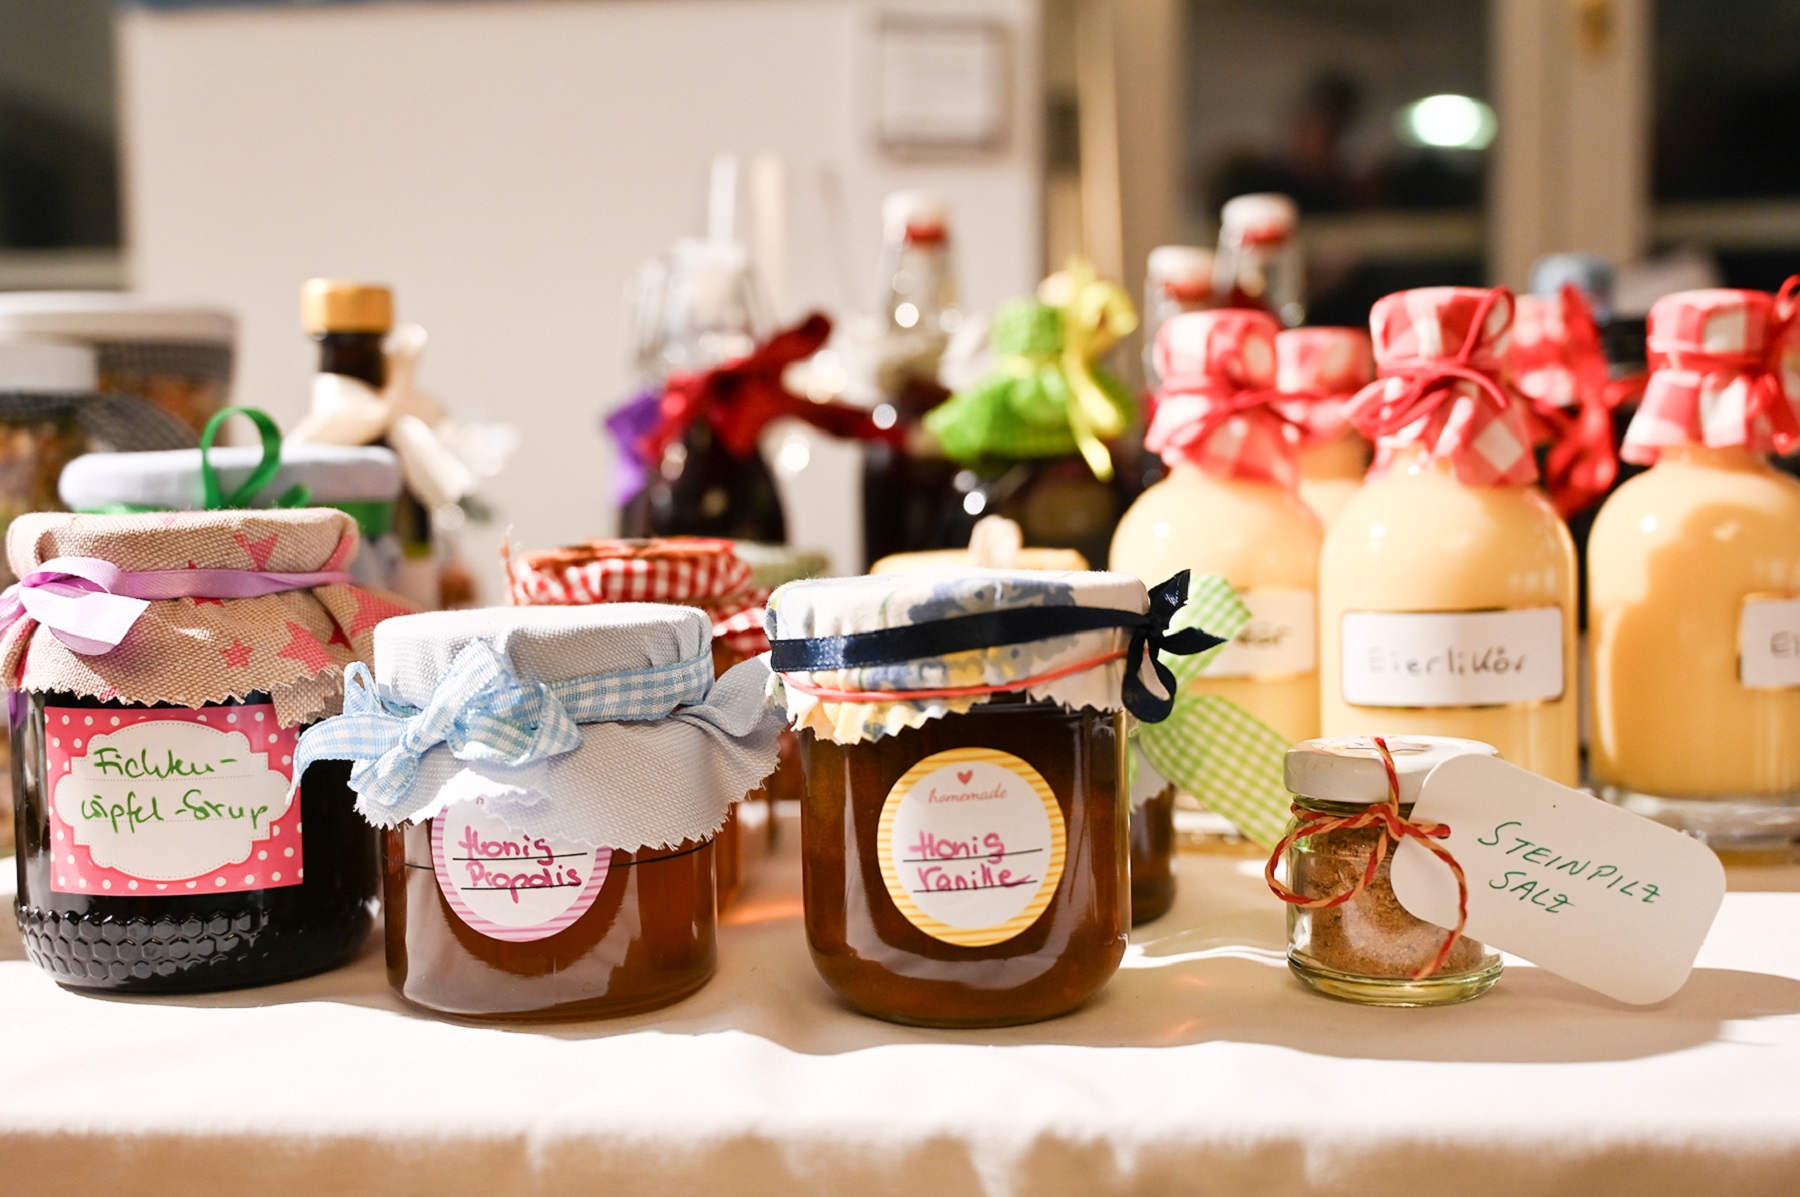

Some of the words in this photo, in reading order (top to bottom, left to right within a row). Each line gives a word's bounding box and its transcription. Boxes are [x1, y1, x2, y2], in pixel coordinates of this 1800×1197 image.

[928, 782, 1008, 803] homemade
[458, 825, 554, 866] Honig
[908, 830, 1006, 865] Honig
[1477, 821, 1661, 903] STEINPILZ
[465, 860, 582, 904] Propolis
[917, 863, 1032, 893] Vanille
[1488, 871, 1576, 914] SALZ
